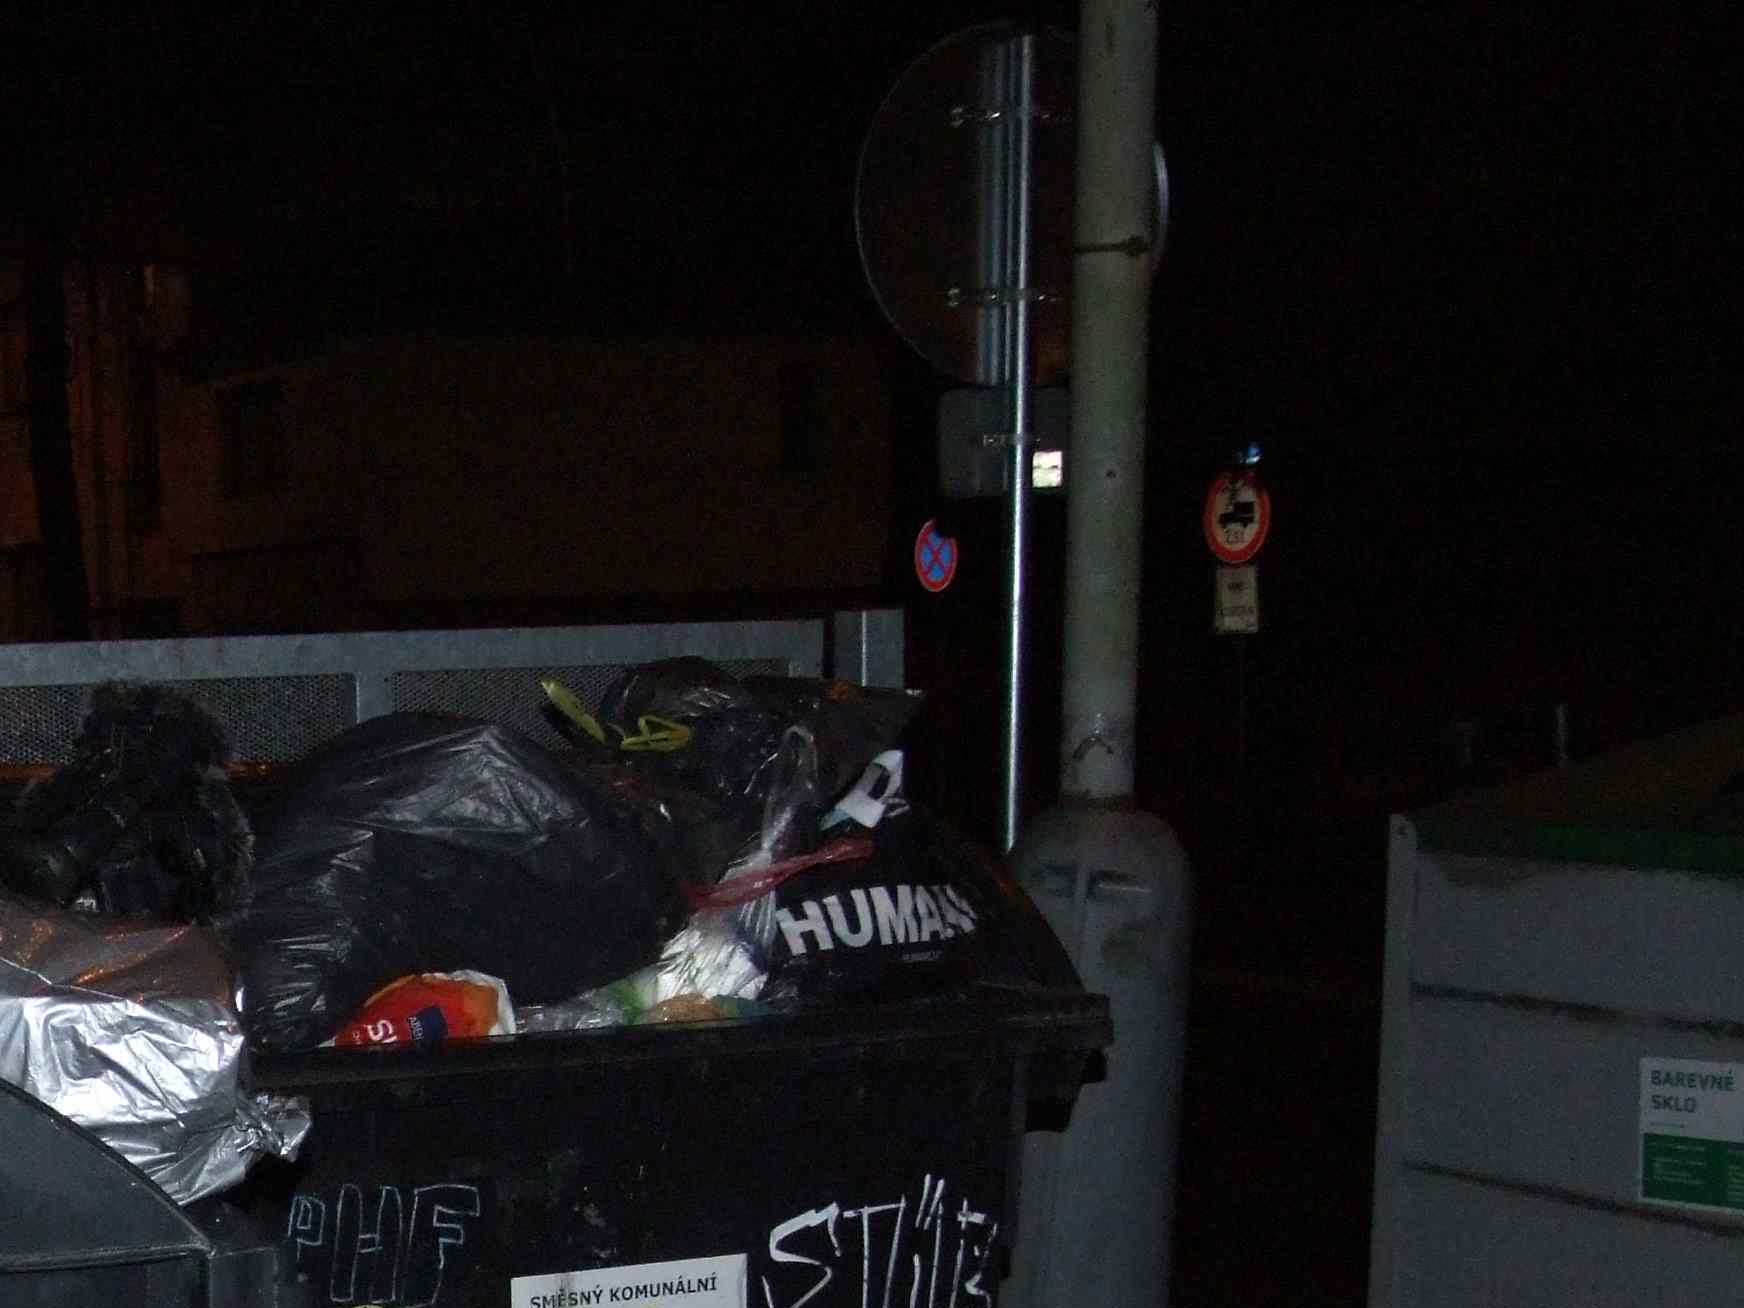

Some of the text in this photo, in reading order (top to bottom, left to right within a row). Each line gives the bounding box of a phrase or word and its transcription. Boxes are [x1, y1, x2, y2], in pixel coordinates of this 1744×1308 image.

[1650, 1069, 1735, 1092] BAREVNÉ
[1650, 1094, 1697, 1114] SKLO
[609, 1271, 718, 1303] KOMUNÁLNÍ
